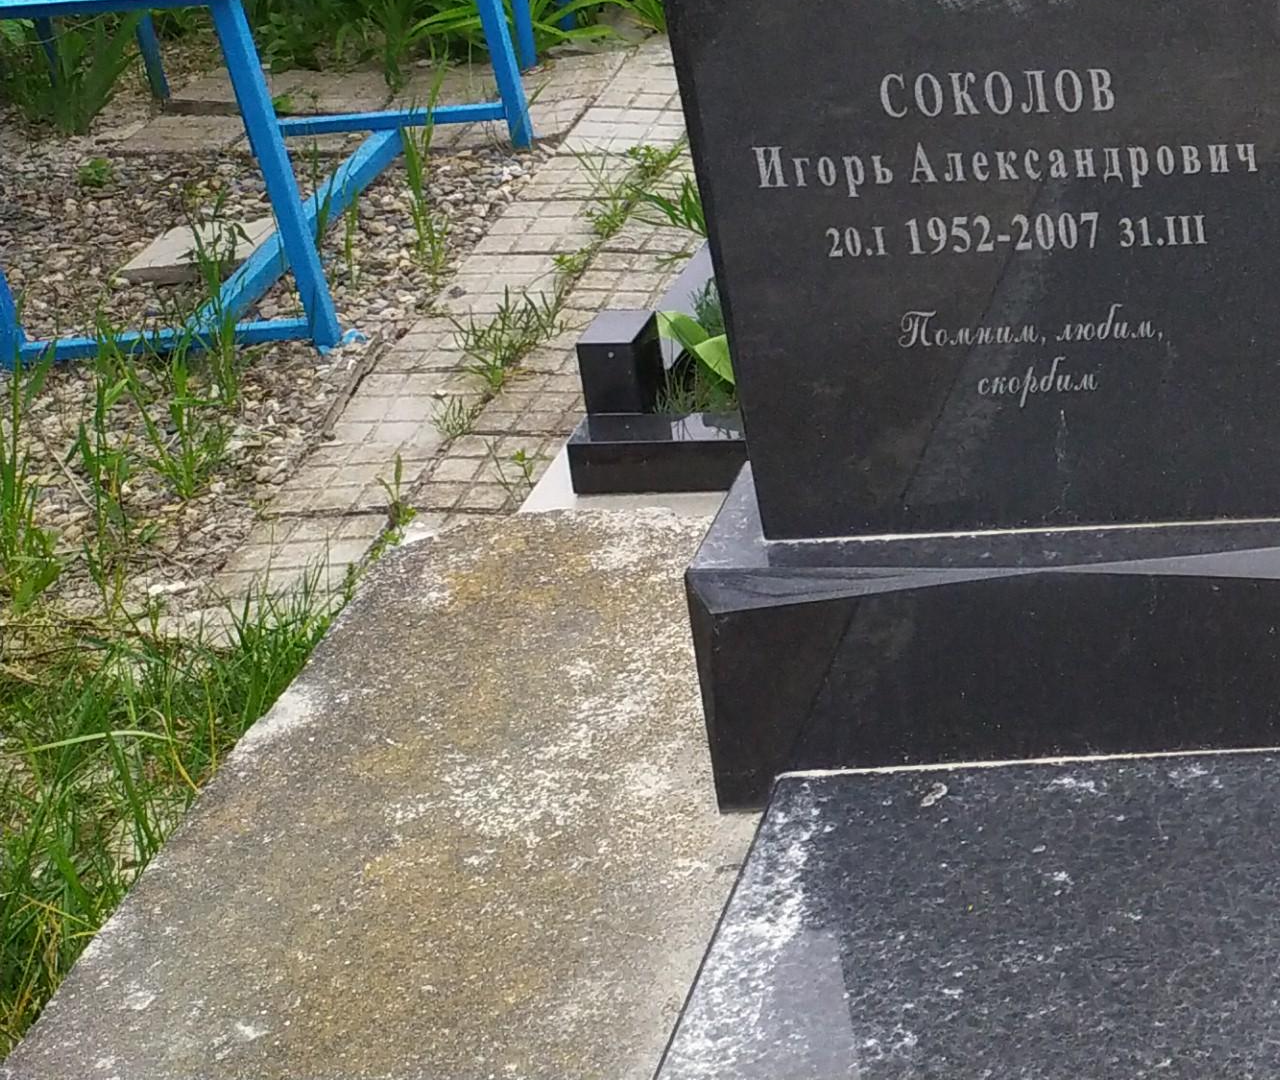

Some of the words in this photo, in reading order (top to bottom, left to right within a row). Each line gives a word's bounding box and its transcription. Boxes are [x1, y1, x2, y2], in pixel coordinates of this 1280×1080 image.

[879, 67, 1117, 119] СОКОЛОВ
[751, 145, 893, 198] Игорь
[910, 141, 1259, 188] Александрович
[825, 226, 888, 258] 20.I
[905, 211, 1101, 256] 1952-2007
[1118, 214, 1209, 249] 31.III
[898, 309, 1047, 348] Помним,
[1055, 303, 1164, 343] любим,
[976, 356, 1099, 408] скорбим
